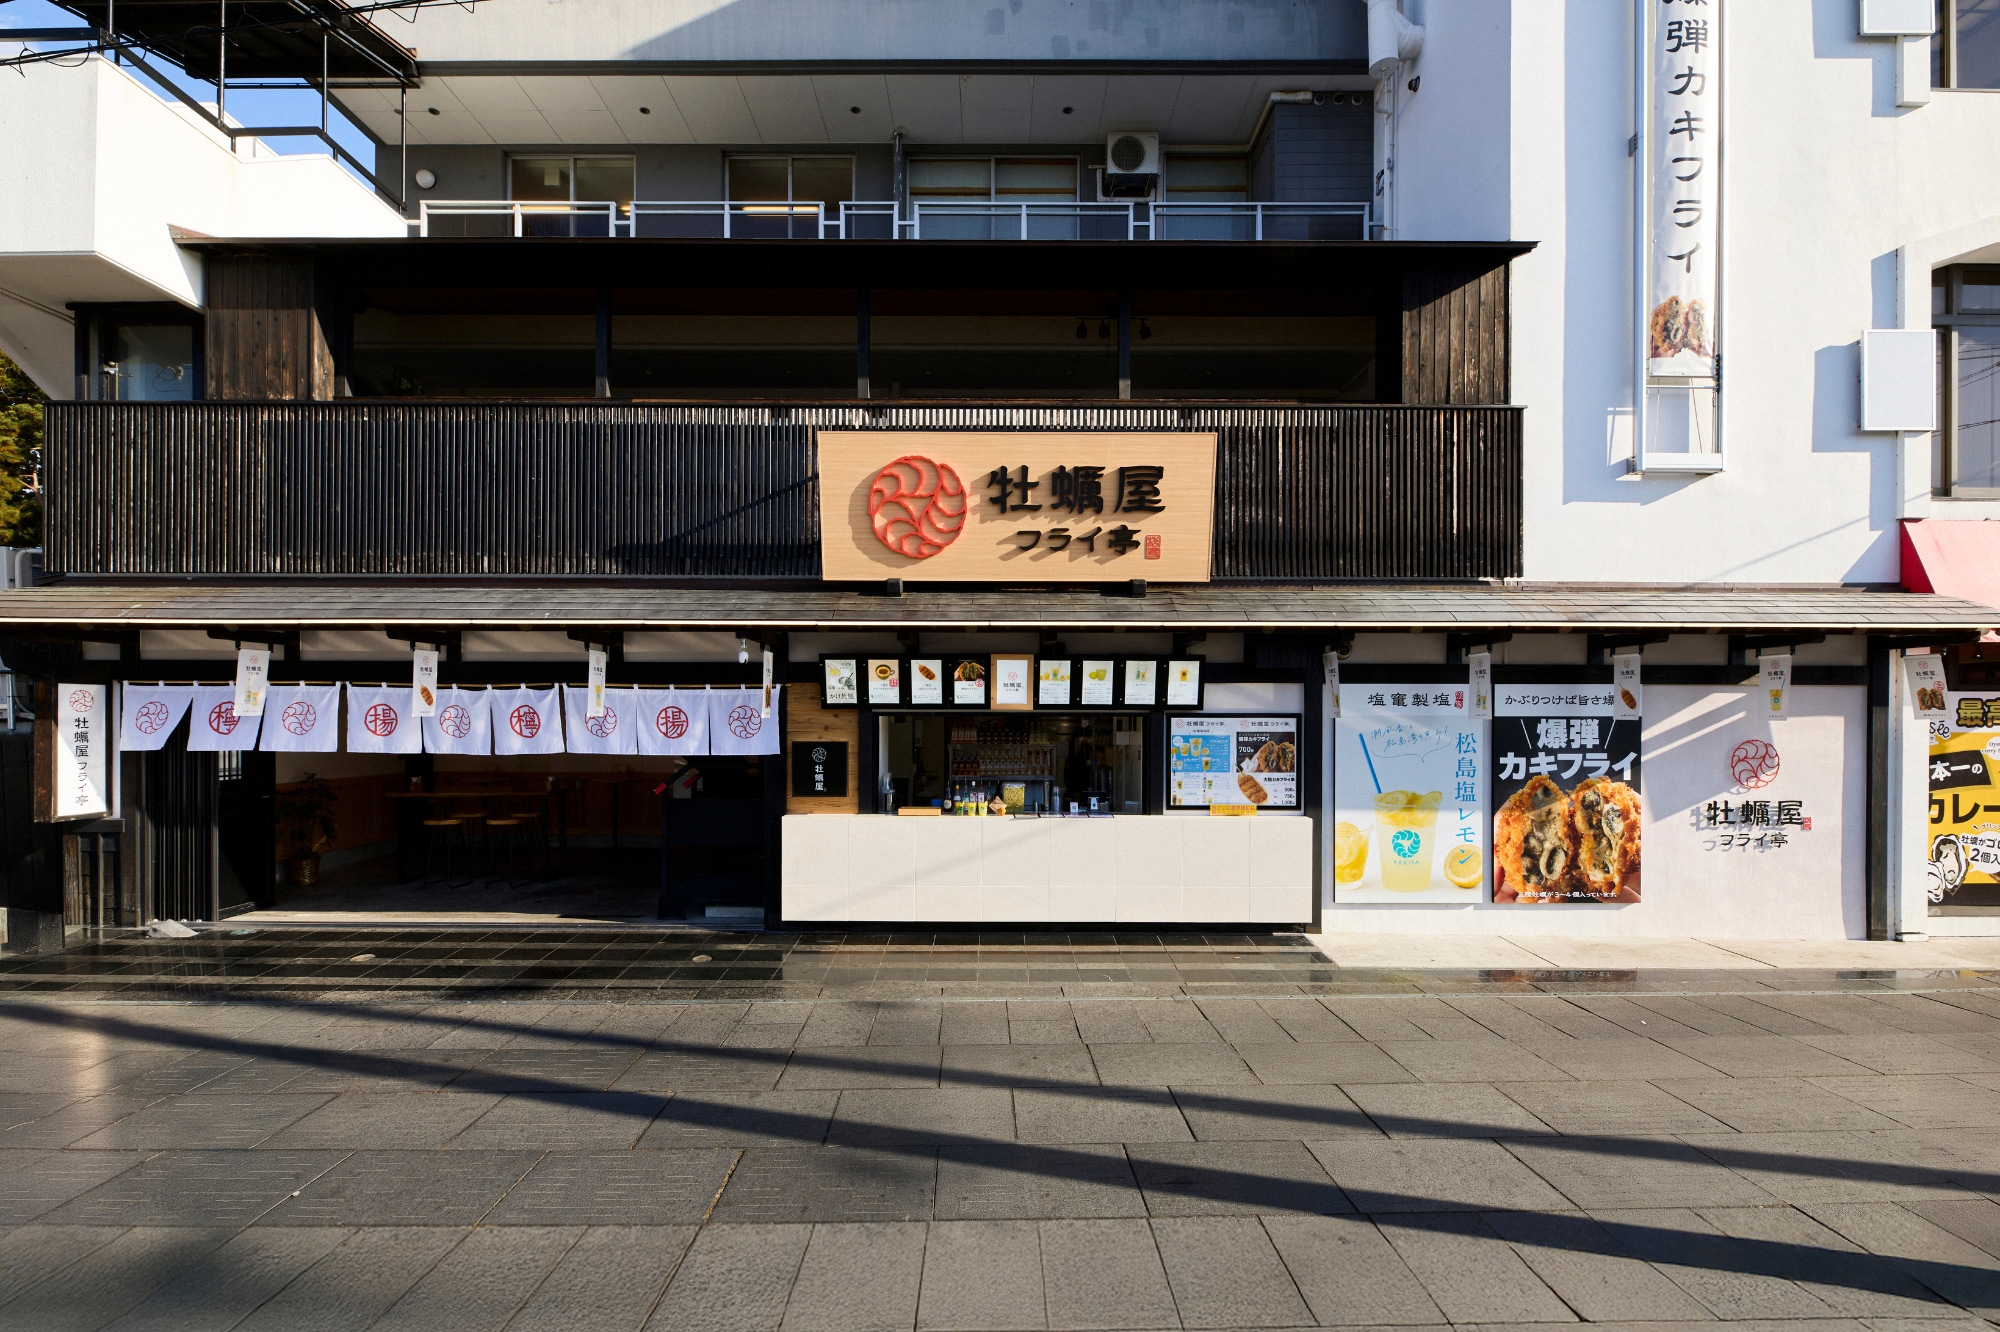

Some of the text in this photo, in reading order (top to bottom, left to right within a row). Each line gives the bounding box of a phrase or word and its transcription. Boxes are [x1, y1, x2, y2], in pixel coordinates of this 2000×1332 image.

[1662, 0, 1709, 273] 弾カキフライ
[986, 465, 1166, 515] 牡蠣屋
[1016, 525, 1142, 556] フライ亭
[1367, 692, 1452, 707] 塩竈製塩
[1536, 718, 1600, 749] 爆弾
[815, 764, 824, 791] 牡蠣屋
[1498, 751, 1638, 780] カキフライ
[1455, 732, 1477, 865] 松島塩レモン
[1706, 800, 1804, 826] 牡蠣屋
[1720, 831, 1788, 848] フライ亭
[1961, 835, 2000, 849] 牡蠣がゴ
